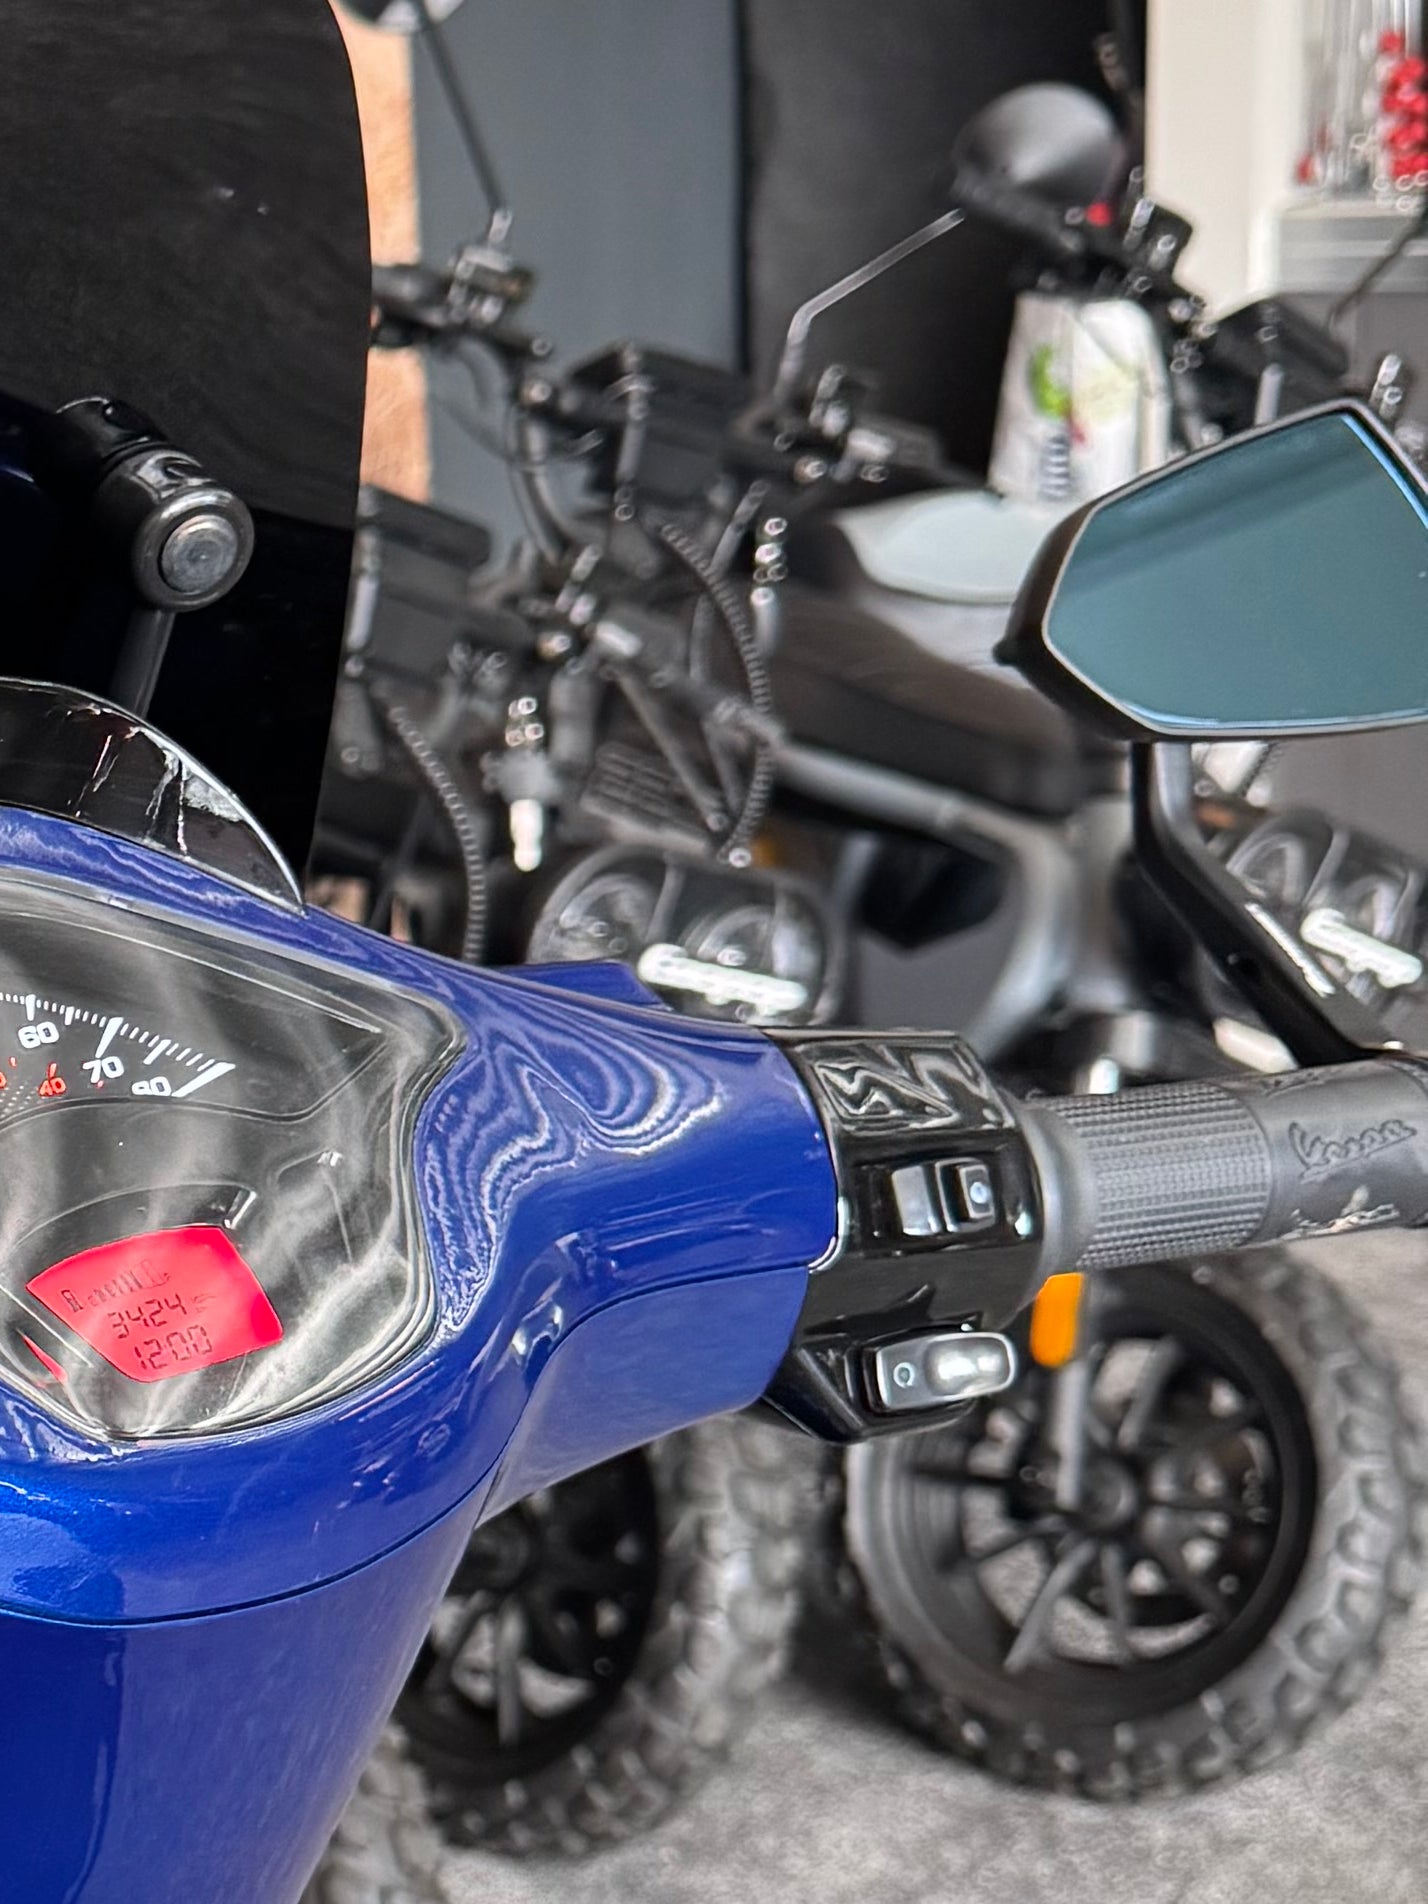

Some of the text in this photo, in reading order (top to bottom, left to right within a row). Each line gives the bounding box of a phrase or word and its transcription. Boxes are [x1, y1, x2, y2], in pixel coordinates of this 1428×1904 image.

[17, 1021, 60, 1049] 60
[81, 1055, 125, 1084] 70
[38, 1076, 67, 1097] 40
[1288, 1118, 1418, 1180] Vespa
[107, 1293, 188, 1339] 3424
